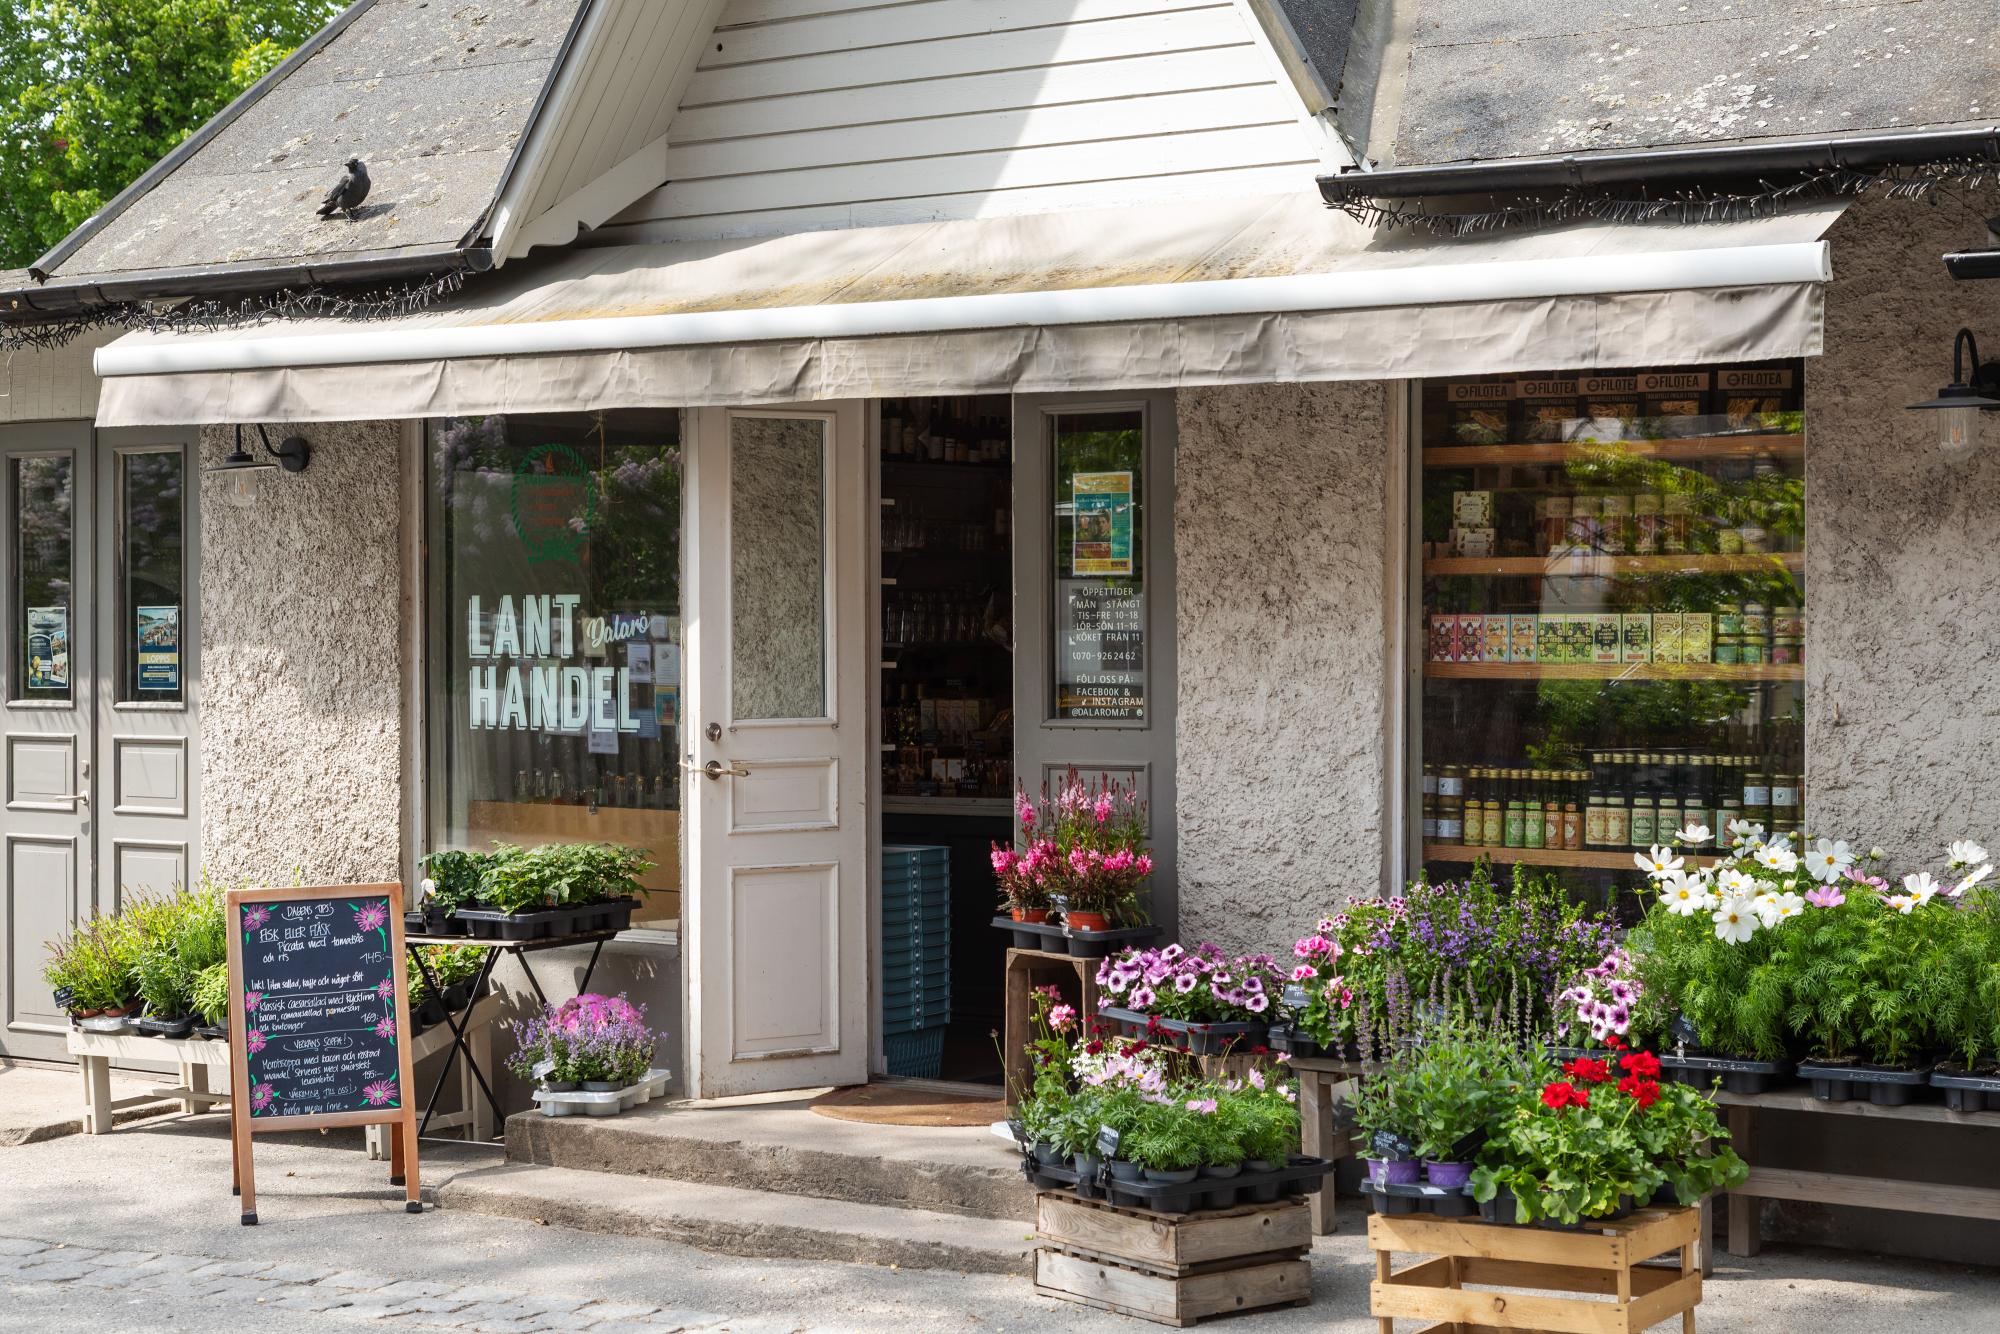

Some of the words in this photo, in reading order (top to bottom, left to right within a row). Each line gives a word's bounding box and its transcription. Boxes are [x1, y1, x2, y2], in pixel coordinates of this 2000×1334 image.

[1659, 375, 1700, 388] FILOTEA
[1741, 372, 1782, 386] FILOTEA
[1470, 386, 1507, 397] FILOTEA
[1538, 382, 1577, 394] FILOTEA
[1082, 586, 1134, 596] ÖPPETTIDER
[1076, 599, 1096, 609] MÅN
[1106, 598, 1140, 609] STÄNGT
[1077, 611, 1111, 620] TIS-FRE
[1115, 611, 1139, 620] 10-18
[469, 594, 580, 659] LANT
[586, 610, 650, 648] Dalarö
[1076, 620, 1114, 631] LÖR-SÖN
[1116, 622, 1138, 630] 11-16
[1076, 631, 1102, 641] KÖKET
[1106, 631, 1129, 641] FRÅN
[1132, 633, 1140, 641] 11
[1076, 673, 1096, 684] FÖLJ
[1099, 675, 1116, 684] OSS
[1076, 687, 1119, 696] FACEBOOK
[1124, 687, 1131, 696] &
[469, 666, 641, 733] HANDEL
[1092, 697, 1144, 706] INSTAGRAM
[1071, 708, 1129, 717] @DALAROMAT
[287, 905, 312, 917] DAGENS
[260, 928, 279, 941] FISK
[284, 926, 306, 939] ELLER
[277, 941, 304, 952] Piccata
[308, 937, 327, 948] med
[331, 933, 365, 947] tomatsås
[263, 953, 275, 963] och
[278, 953, 290, 962] ris
[318, 976, 330, 986] och
[328, 995, 344, 1005] med
[259, 1023, 269, 1032] och
[304, 1055, 319, 1066] med
[322, 1053, 341, 1063] bacon
[342, 1051, 356, 1060] och
[323, 1063, 339, 1073] med
